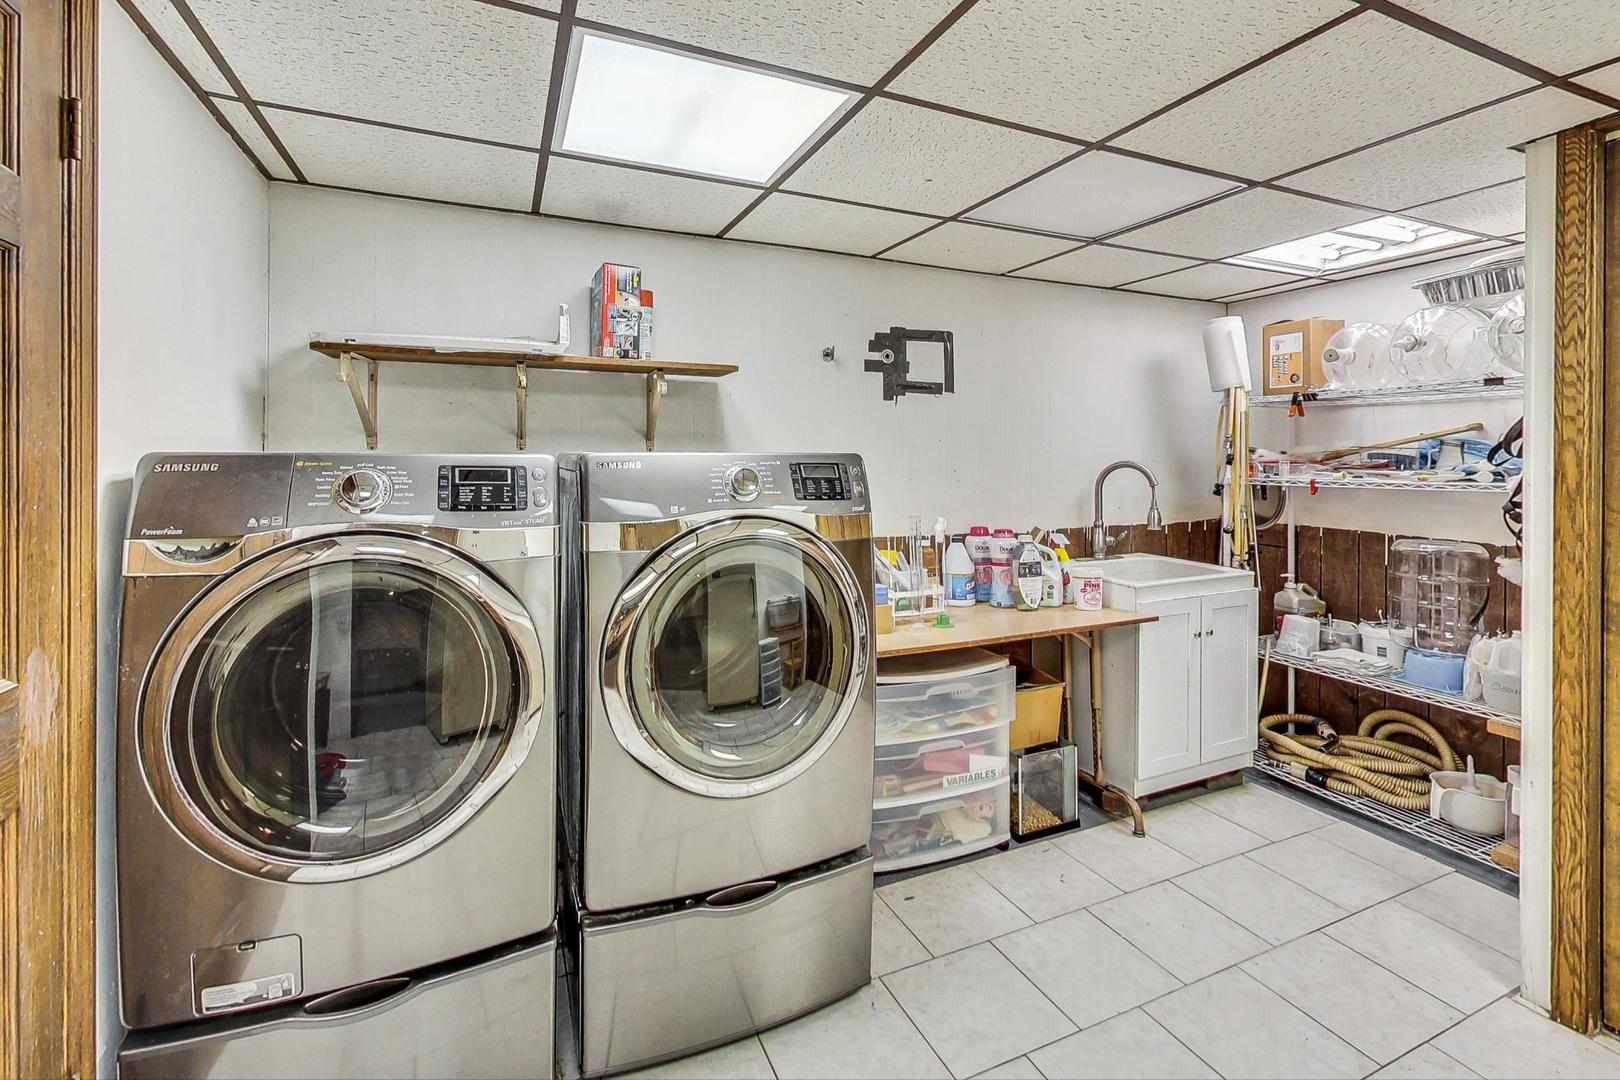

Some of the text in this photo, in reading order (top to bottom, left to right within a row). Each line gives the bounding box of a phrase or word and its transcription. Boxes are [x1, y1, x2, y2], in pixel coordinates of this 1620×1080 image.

[153, 463, 220, 473] SAMSUNG
[596, 460, 642, 470] SAMSUNG
[141, 526, 184, 536] PowerFoam
[946, 769, 996, 785] VARIABLES
